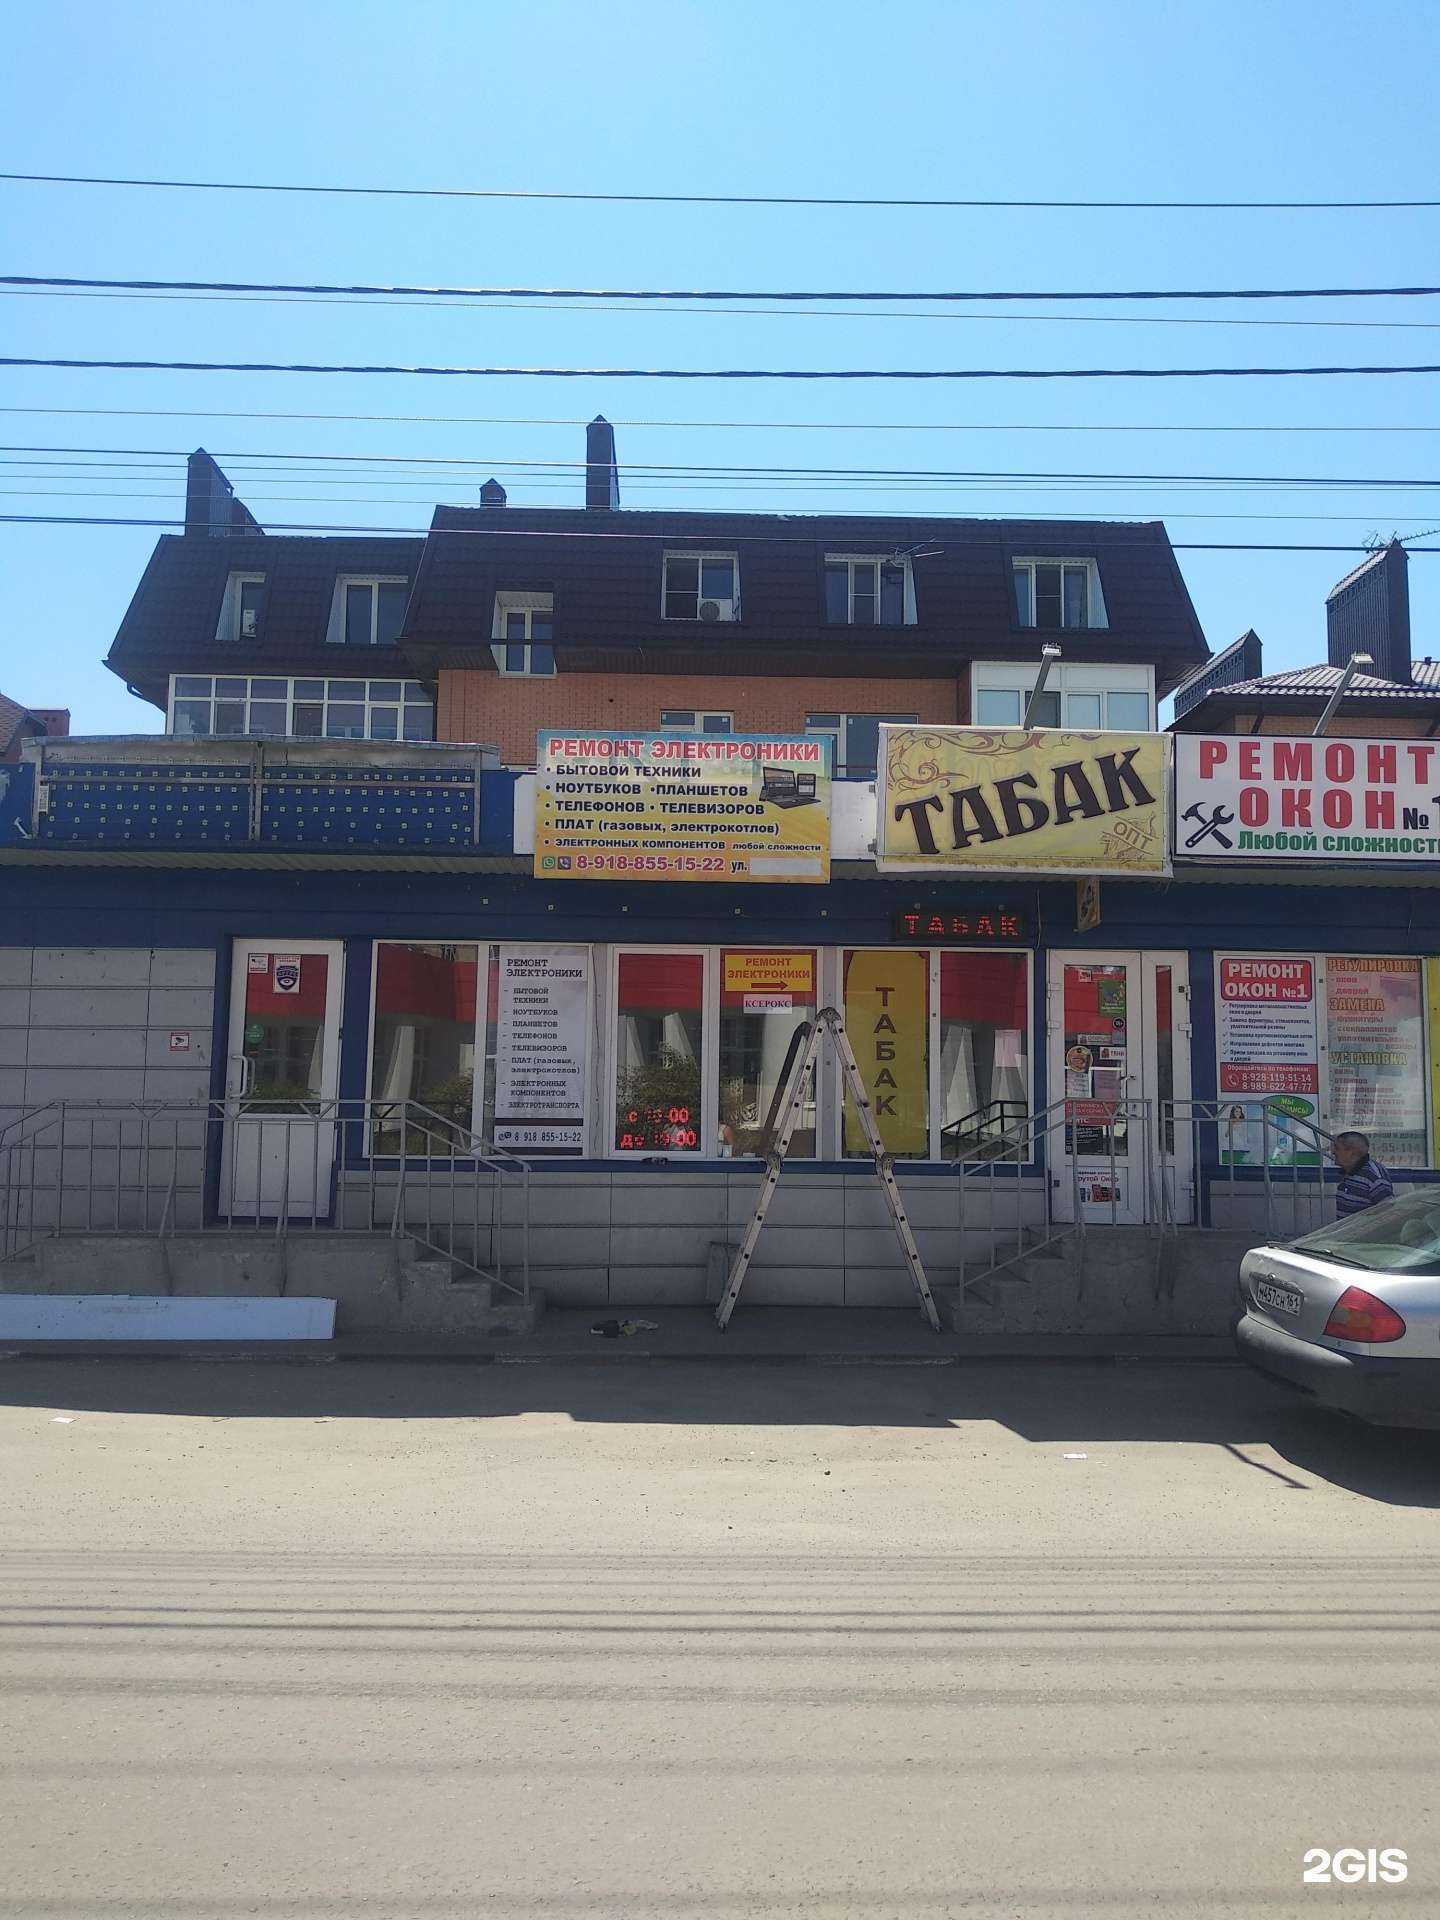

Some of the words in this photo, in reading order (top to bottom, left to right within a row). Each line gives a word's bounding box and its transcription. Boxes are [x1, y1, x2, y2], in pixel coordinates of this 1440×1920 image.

[549, 739, 644, 758] РЕМОНТ
[651, 741, 819, 760] ЭЛЕКТРОНИКИ
[1200, 740, 1435, 785] РЕМОНТ
[556, 764, 629, 776] БЫТОВОЙ
[634, 766, 701, 778] ТЕХНИКИ
[555, 782, 641, 794] НОУТБУКОВ
[656, 784, 748, 796] ПЛАНШЕТОВ
[555, 801, 645, 812] ТЕЛЕФОНОВ
[660, 802, 765, 815] ТЕЛЕВИЗОРОВ
[895, 747, 1156, 855] ТАБАК
[1239, 786, 1395, 829] ОКОН
[555, 819, 594, 830] ПЛАТ
[599, 820, 666, 833] (газовых,
[671, 822, 779, 836] электрокотлов)
[1114, 821, 1153, 849] ОПТ
[555, 838, 639, 848] ЭЛЕКТРОННЫХ
[642, 840, 726, 850] КОМПОНЕНТОВ
[733, 842, 765, 850] любой
[1238, 831, 1317, 851] Любой
[1323, 835, 1440, 854] сложност
[576, 855, 724, 871] 8-918-855-15-22
[731, 860, 748, 873] ул.
[904, 915, 1019, 936] ТАБАК
[506, 958, 549, 967] РЕМОНТ
[745, 957, 792, 967] РЕМОНТ
[1328, 959, 1418, 973] РЕГУЛИРОВКА
[506, 968, 583, 978] ЭЛЕКТРОНИКИ
[727, 969, 811, 979] ЭЛЕКТРОНИКИ
[1228, 962, 1304, 979] РЕМОНТ
[513, 986, 549, 995] БЫТОВОЙ
[1224, 982, 1277, 998] ОКОН
[1282, 983, 1308, 998] №1
[745, 1000, 792, 1008] КСЕРОКС
[1329, 997, 1385, 1012] ЗАМЕНА
[512, 1020, 559, 1028] ПЛАНШЕТОВ
[512, 1032, 558, 1040] ТЕЛЕФОНОВ
[873, 986, 897, 1116] ТАБАК
[510, 1066, 581, 1075] электрокотлов)
[1242, 1073, 1312, 1082] 8-928-119-51-14
[510, 1089, 567, 1097] КОМПОНЕНТОВ
[1242, 1082, 1312, 1091] 8-989-622-47-77
[514, 1132, 519, 1142] 8
[524, 1132, 538, 1142] 918
[541, 1132, 582, 1142] 855-15-22
